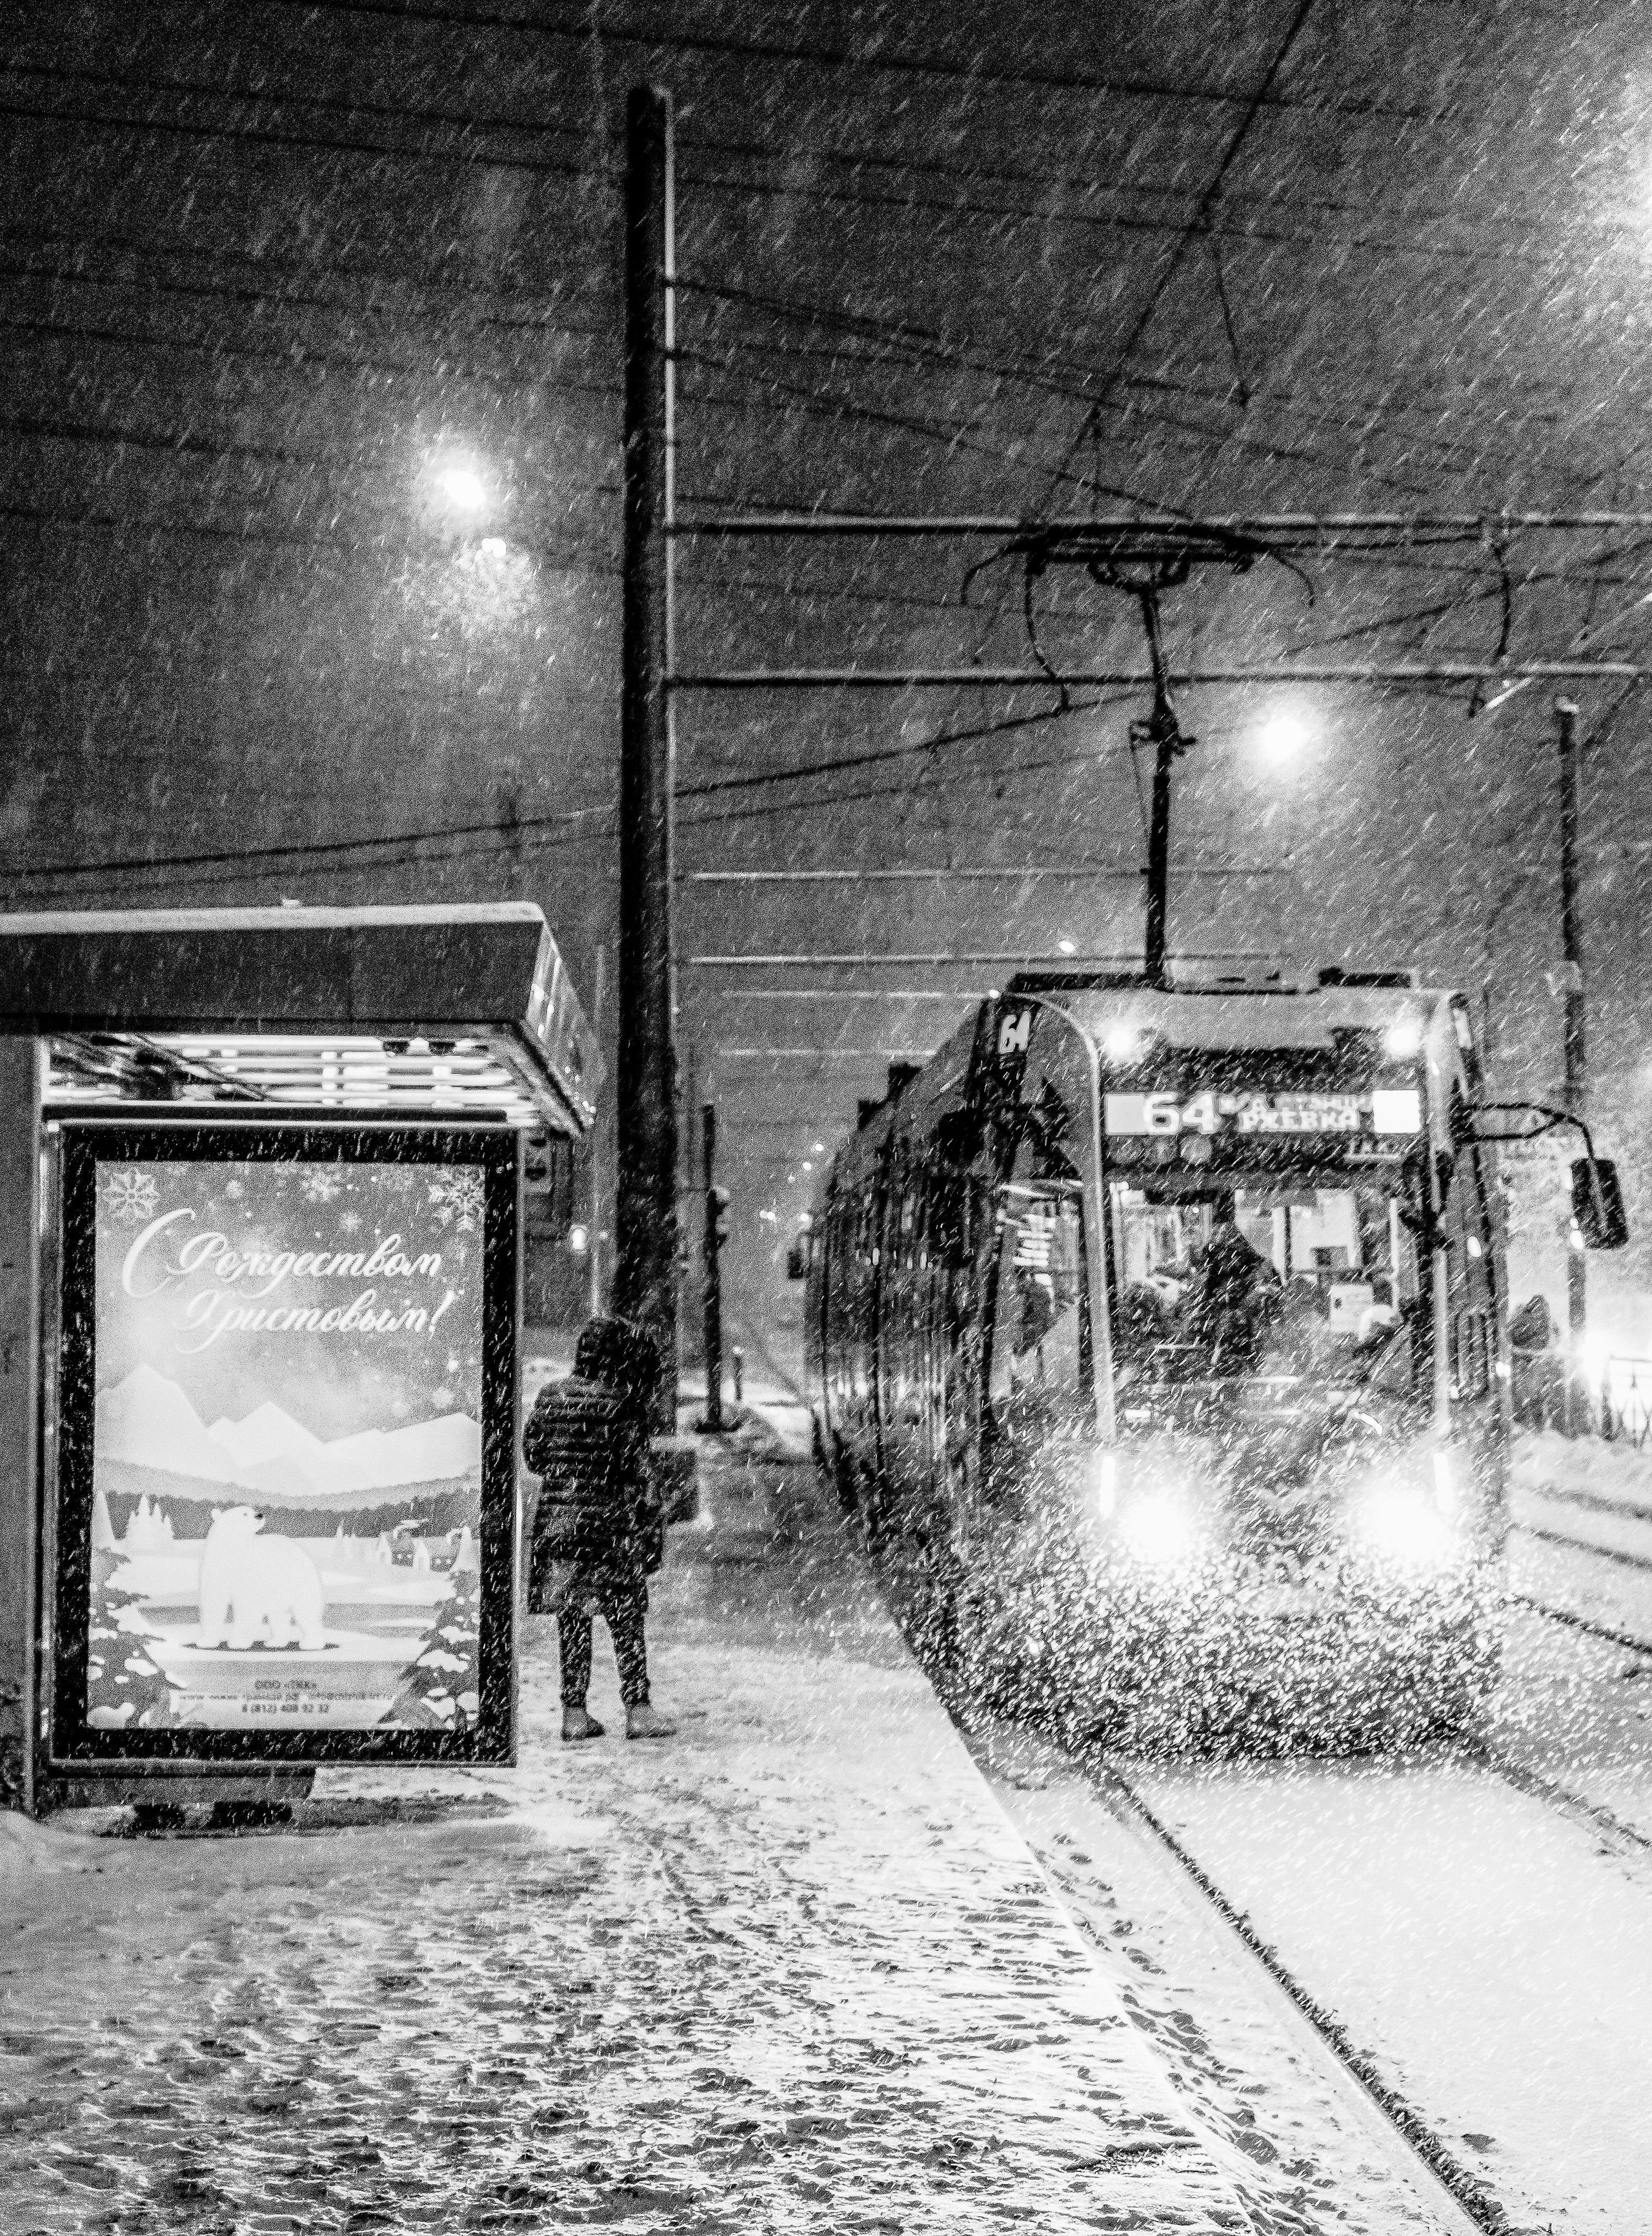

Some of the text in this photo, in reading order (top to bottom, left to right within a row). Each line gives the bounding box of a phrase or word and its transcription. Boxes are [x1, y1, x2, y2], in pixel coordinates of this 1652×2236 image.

[1000, 1011, 1031, 1053] 64
[1145, 1092, 1219, 1134] 64
[122, 1207, 442, 1299] С Рождеством
[172, 1288, 455, 1354] Христовым!
[250, 1703, 277, 1714] (812)
